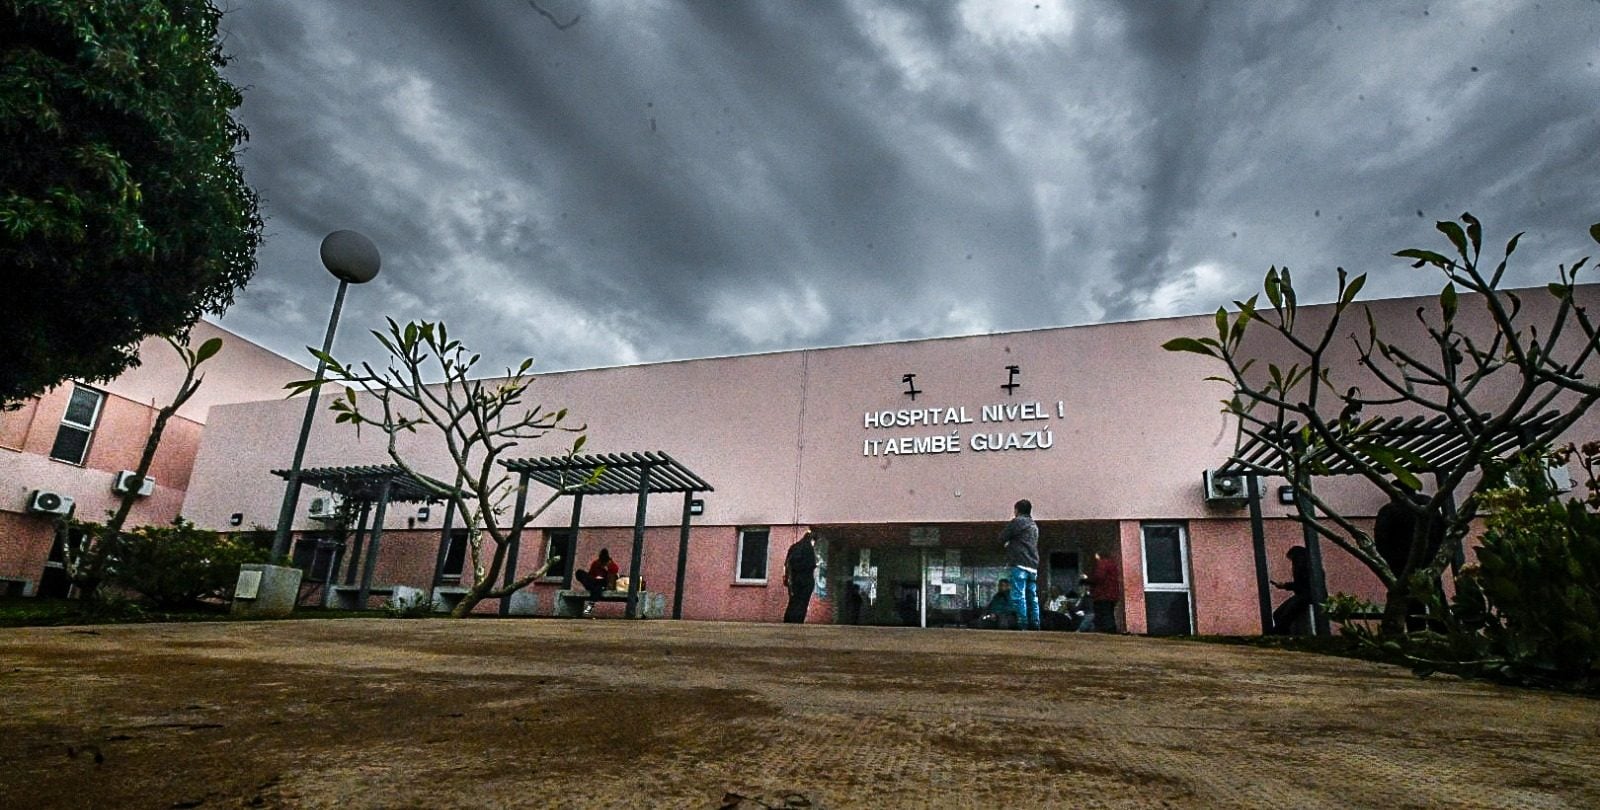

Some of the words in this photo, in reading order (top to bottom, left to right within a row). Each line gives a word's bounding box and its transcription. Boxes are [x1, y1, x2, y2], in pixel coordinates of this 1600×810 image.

[864, 406, 973, 428] HOSPITAL
[982, 402, 1049, 422] NIVEL
[1057, 401, 1064, 418] I
[863, 430, 960, 456] ITAEMBÉ
[970, 425, 1053, 450] GUAZÚ
